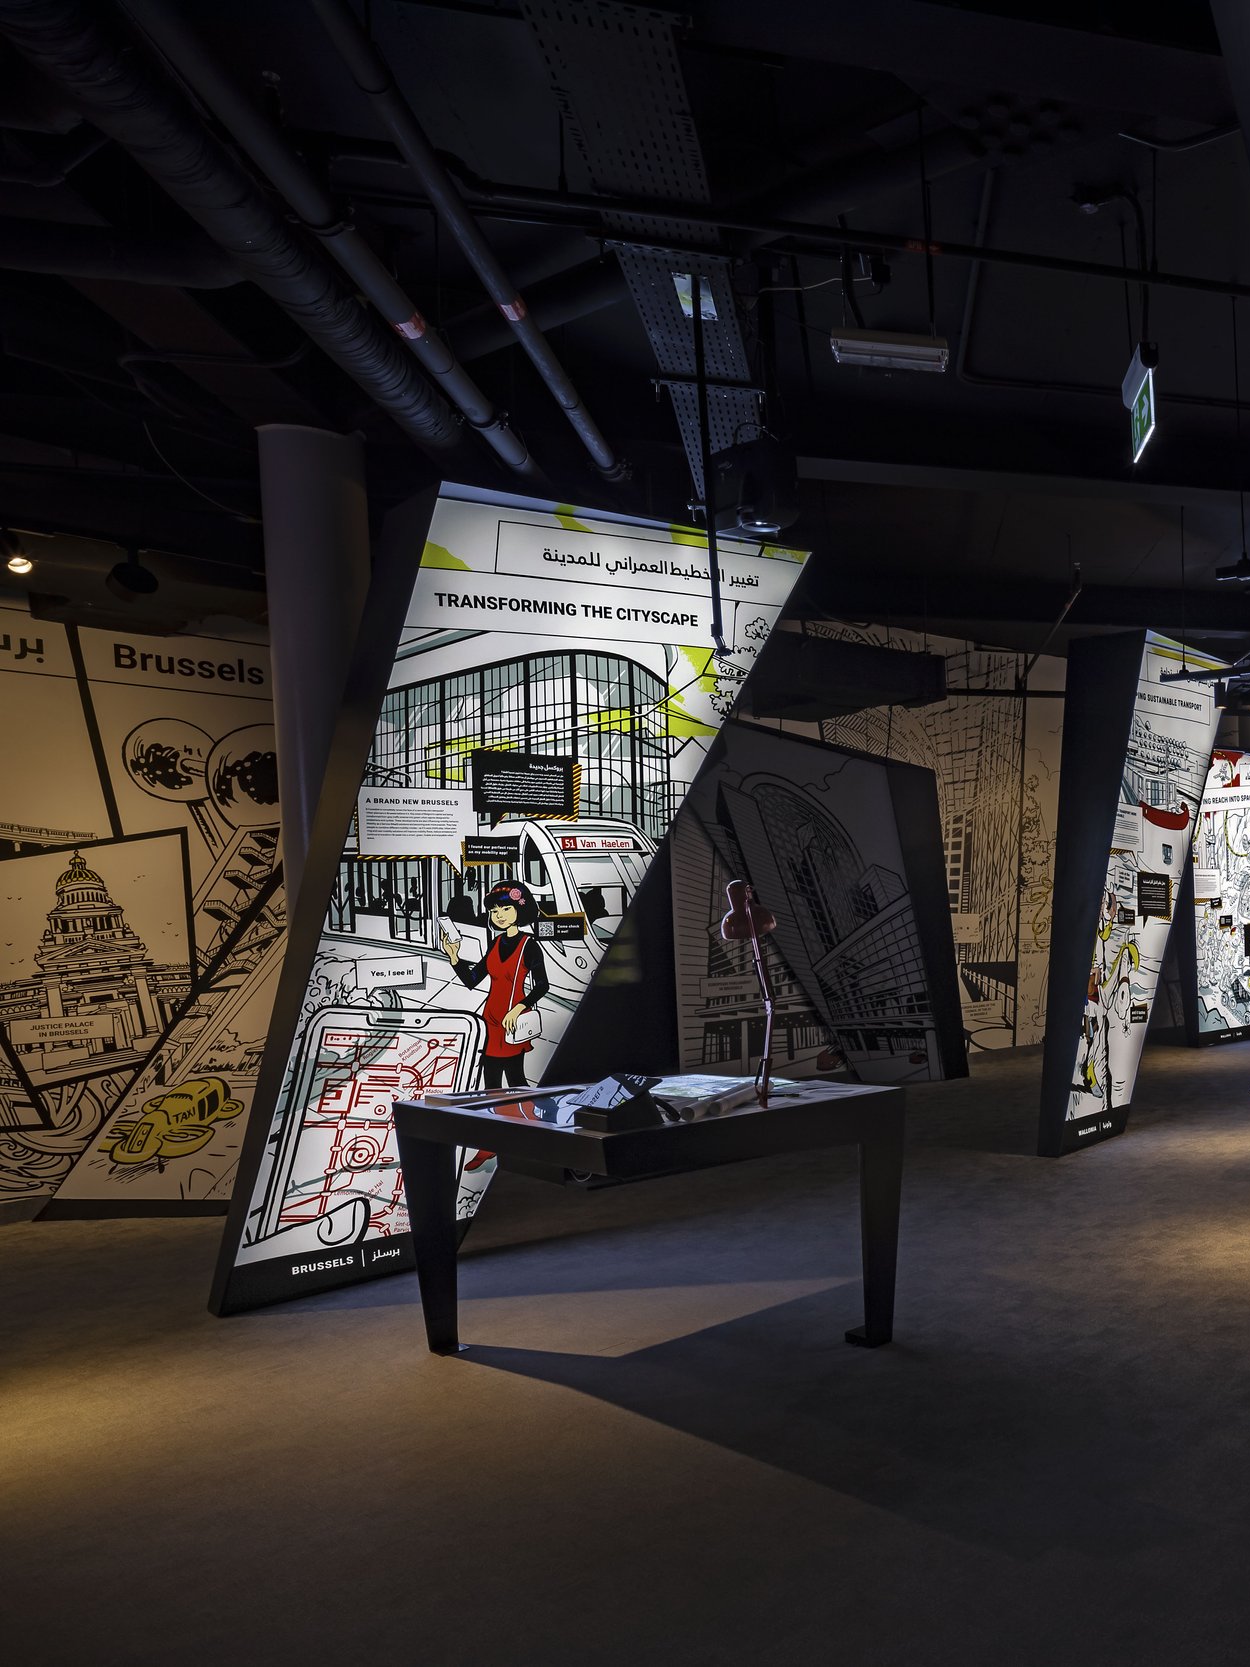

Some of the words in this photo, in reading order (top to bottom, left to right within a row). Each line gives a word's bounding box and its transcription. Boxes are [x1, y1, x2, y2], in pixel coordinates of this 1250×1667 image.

[542, 547, 601, 568] للمدينة
[606, 556, 668, 576] العمراني
[729, 574, 760, 589] تغيير
[434, 592, 577, 617] TRANSFORMING
[581, 603, 613, 620] THE
[616, 607, 699, 628] CITYSCAPE
[113, 643, 265, 686] Brussels
[1147, 693, 1177, 707] SUSTAINABLE
[1178, 699, 1202, 712] TRANSPORT
[373, 797, 400, 805] BRAND
[1212, 796, 1228, 804] REACH
[1229, 795, 1240, 803] INTO
[564, 839, 575, 848] 51
[580, 839, 597, 848] Van
[601, 839, 630, 848] Haelen
[30, 1021, 63, 1032] JUSTICE
[64, 1020, 95, 1029] PALACE
[49, 1028, 89, 1038] BRUSSELS
[172, 1106, 196, 1125] TAXI
[291, 1256, 354, 1276] BRUSSELS
